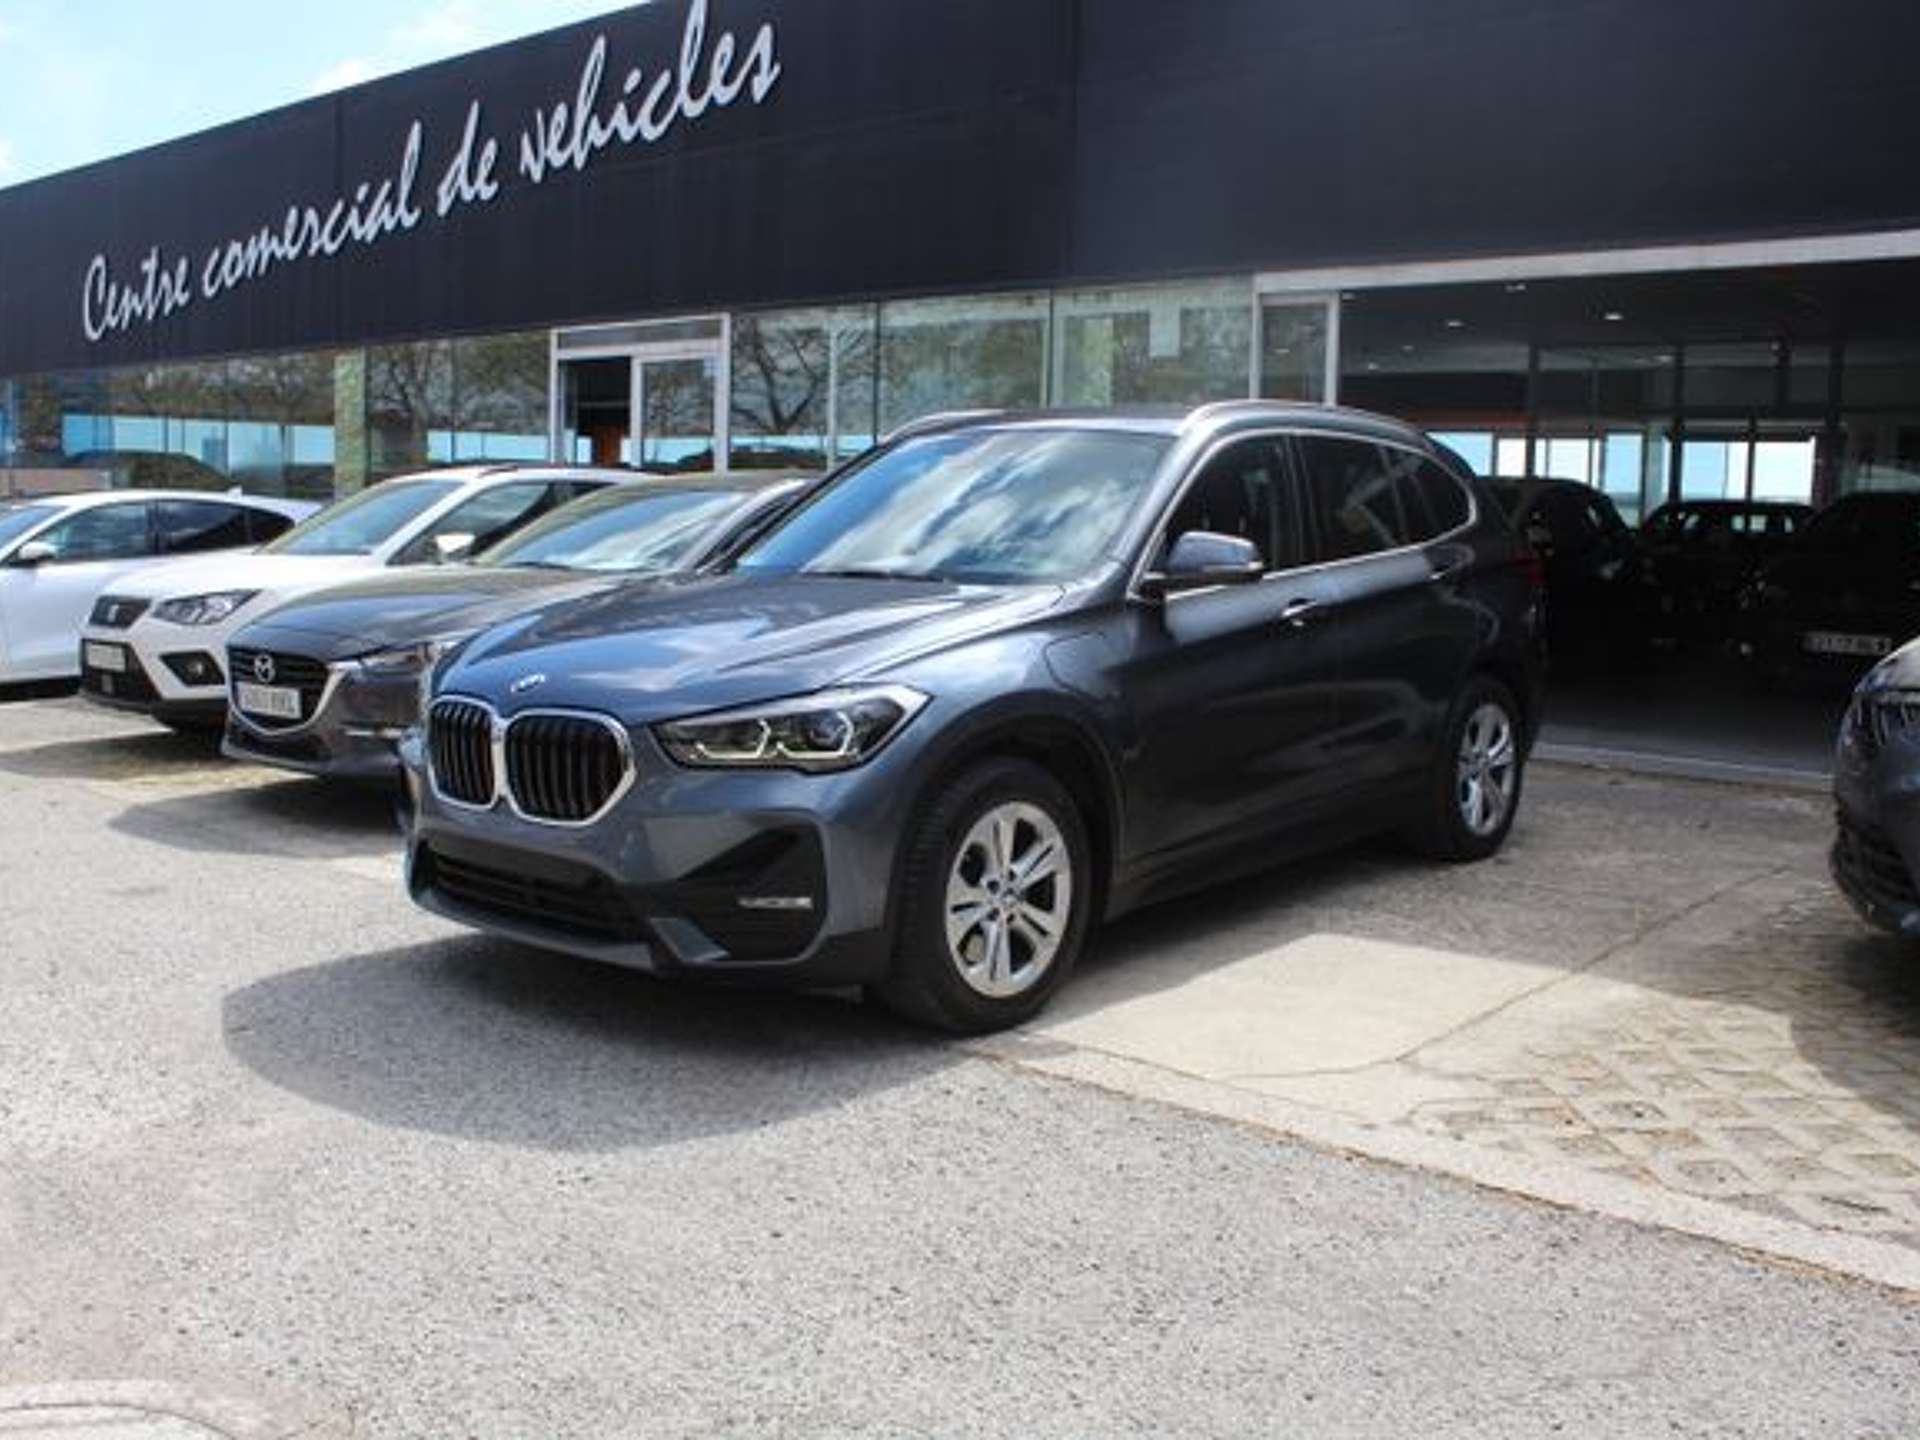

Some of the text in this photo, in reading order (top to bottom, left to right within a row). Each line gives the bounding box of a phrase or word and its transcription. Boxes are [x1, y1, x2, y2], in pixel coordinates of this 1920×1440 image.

[83, 0, 781, 341] Centre comercial de vehicles
